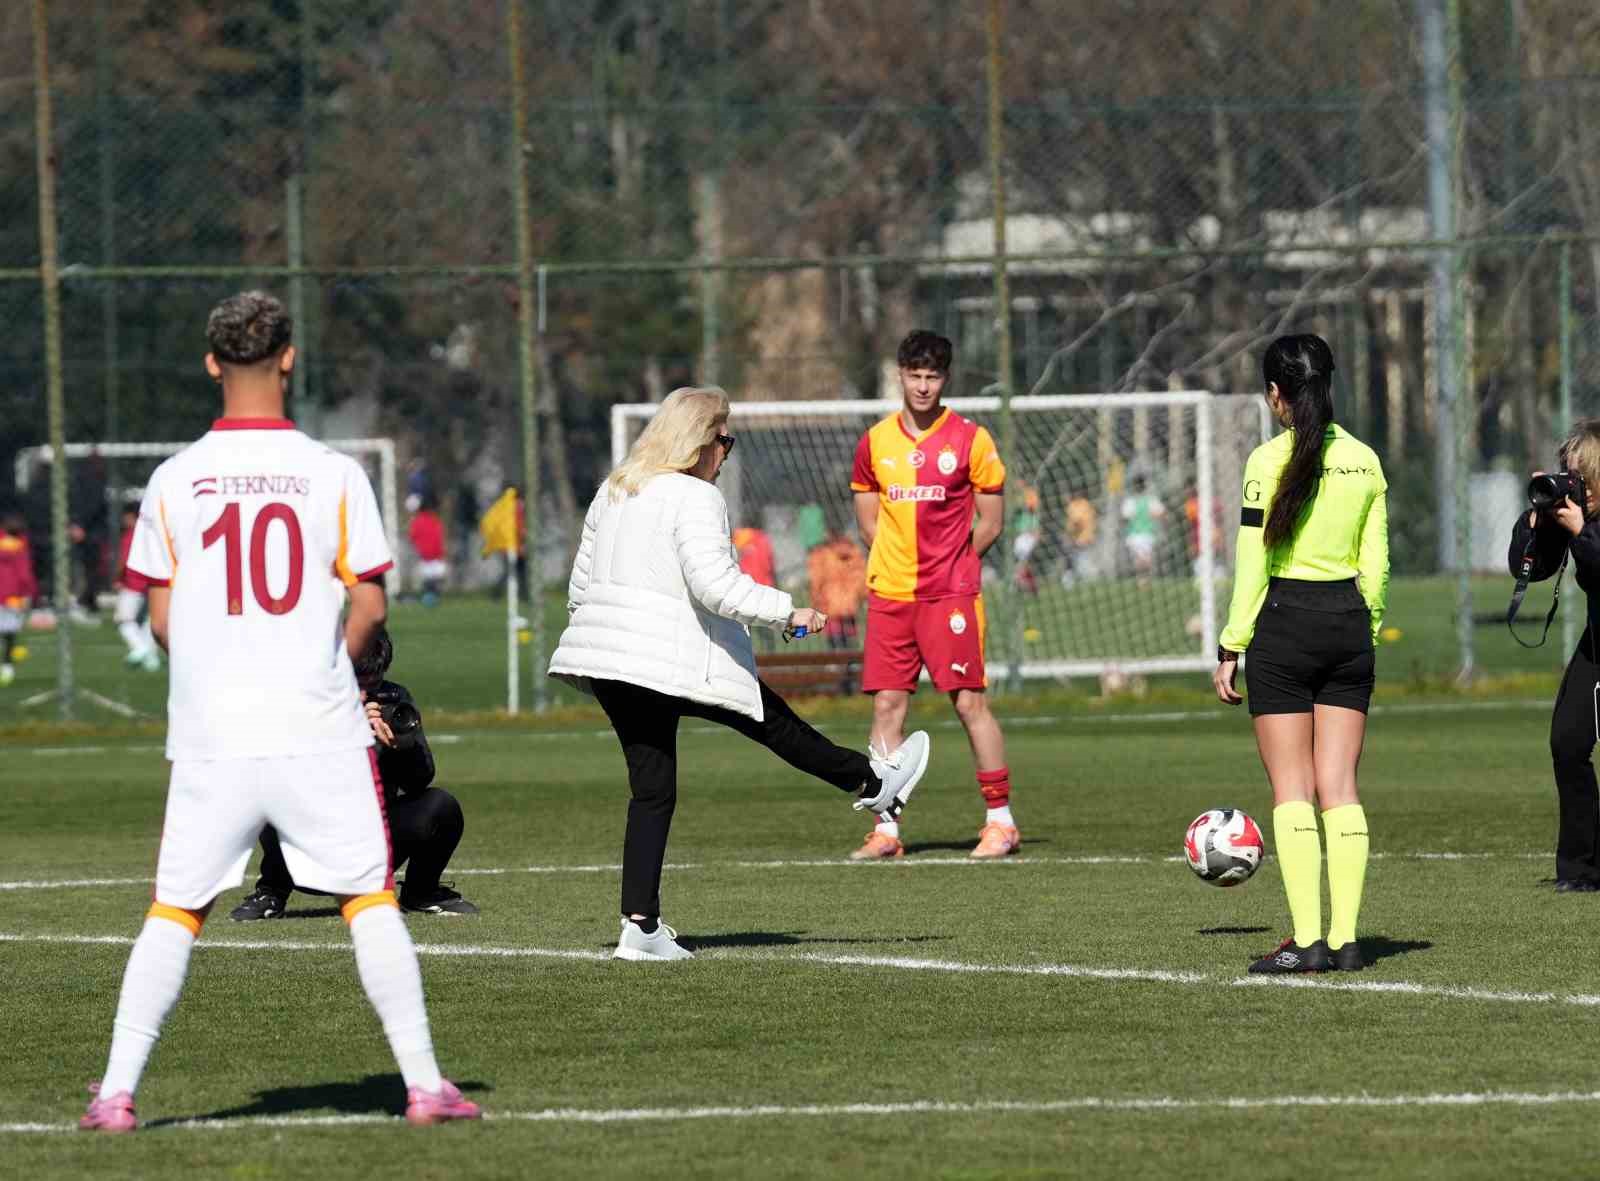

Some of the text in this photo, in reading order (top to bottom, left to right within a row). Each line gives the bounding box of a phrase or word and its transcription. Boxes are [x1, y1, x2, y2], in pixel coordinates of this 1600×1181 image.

[888, 485, 945, 501] ÜLKER
[1244, 479, 1262, 502] G
[202, 502, 304, 616] 10
